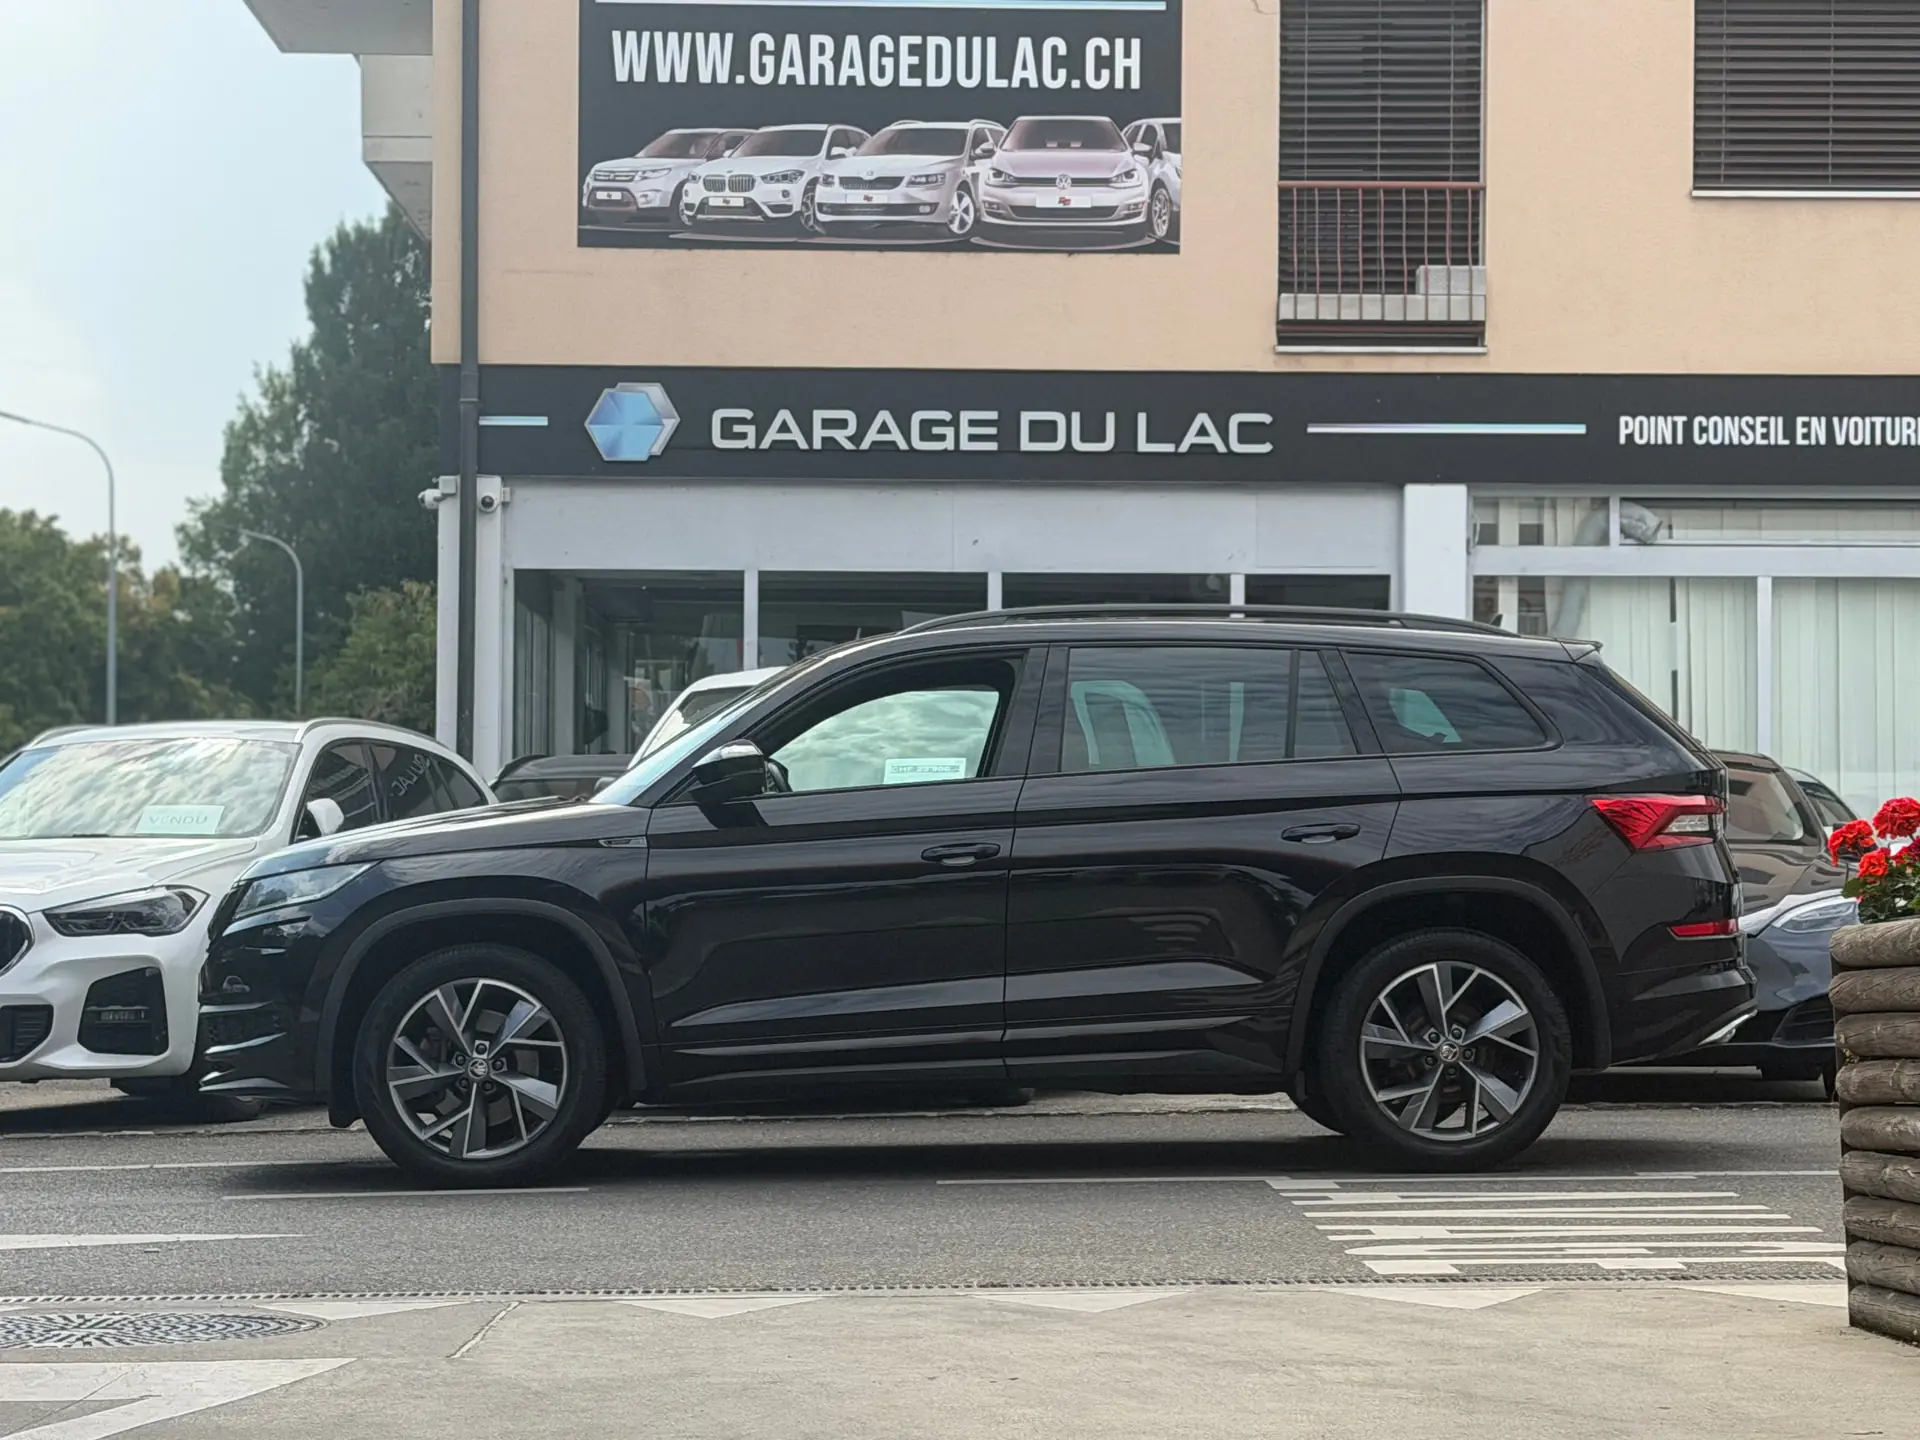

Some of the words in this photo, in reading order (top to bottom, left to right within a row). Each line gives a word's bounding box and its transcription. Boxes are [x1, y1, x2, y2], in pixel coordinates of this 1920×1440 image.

[611, 30, 1141, 90] WWW.GARAGEDULAC.CH
[711, 408, 999, 451] GARAGE
[1019, 410, 1115, 452] DU
[1137, 412, 1274, 453] LAC
[1619, 415, 1688, 445] POINT
[1692, 415, 1791, 446] CONSEIL
[1795, 416, 1827, 446] EN
[1832, 416, 1920, 446] VOITUR
[149, 815, 208, 825] VENDU
